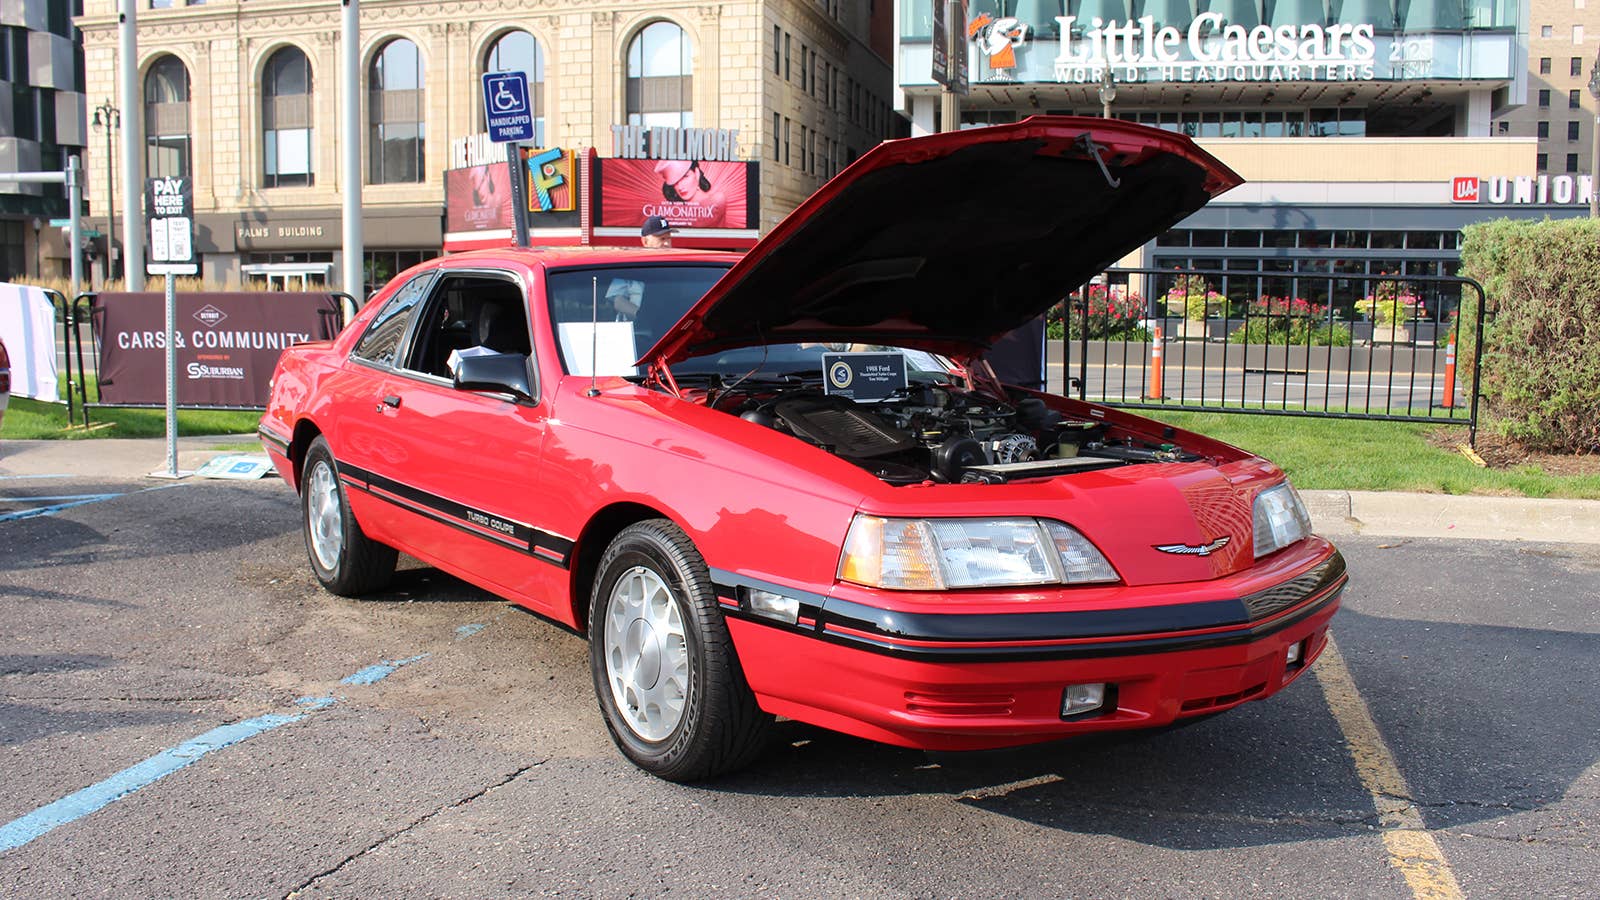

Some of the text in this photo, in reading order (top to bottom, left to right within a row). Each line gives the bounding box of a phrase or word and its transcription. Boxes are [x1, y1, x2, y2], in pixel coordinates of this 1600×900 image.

[1054, 11, 1376, 63] Little Caesars
[1055, 67, 1138, 83] WORLD
[1162, 64, 1375, 82] HEADQUARTERS
[490, 115, 530, 127] HANDICAPPED
[498, 126, 524, 137] PARKING
[611, 125, 741, 162] THE FILLMORE
[154, 179, 183, 195] PAY
[527, 147, 564, 212] F
[1488, 174, 1593, 204] UNION
[154, 195, 184, 206] HERE
[155, 206, 184, 215] TO EXIT
[642, 204, 714, 218] GLAMONATRIX
[239, 226, 323, 238] PALMS BUILDING
[118, 330, 310, 350] CARS & COMMUNITY
[200, 364, 244, 376] SUBURBAN
[879, 364, 891, 372] Ford
[466, 510, 514, 534] TURBO COUPE
